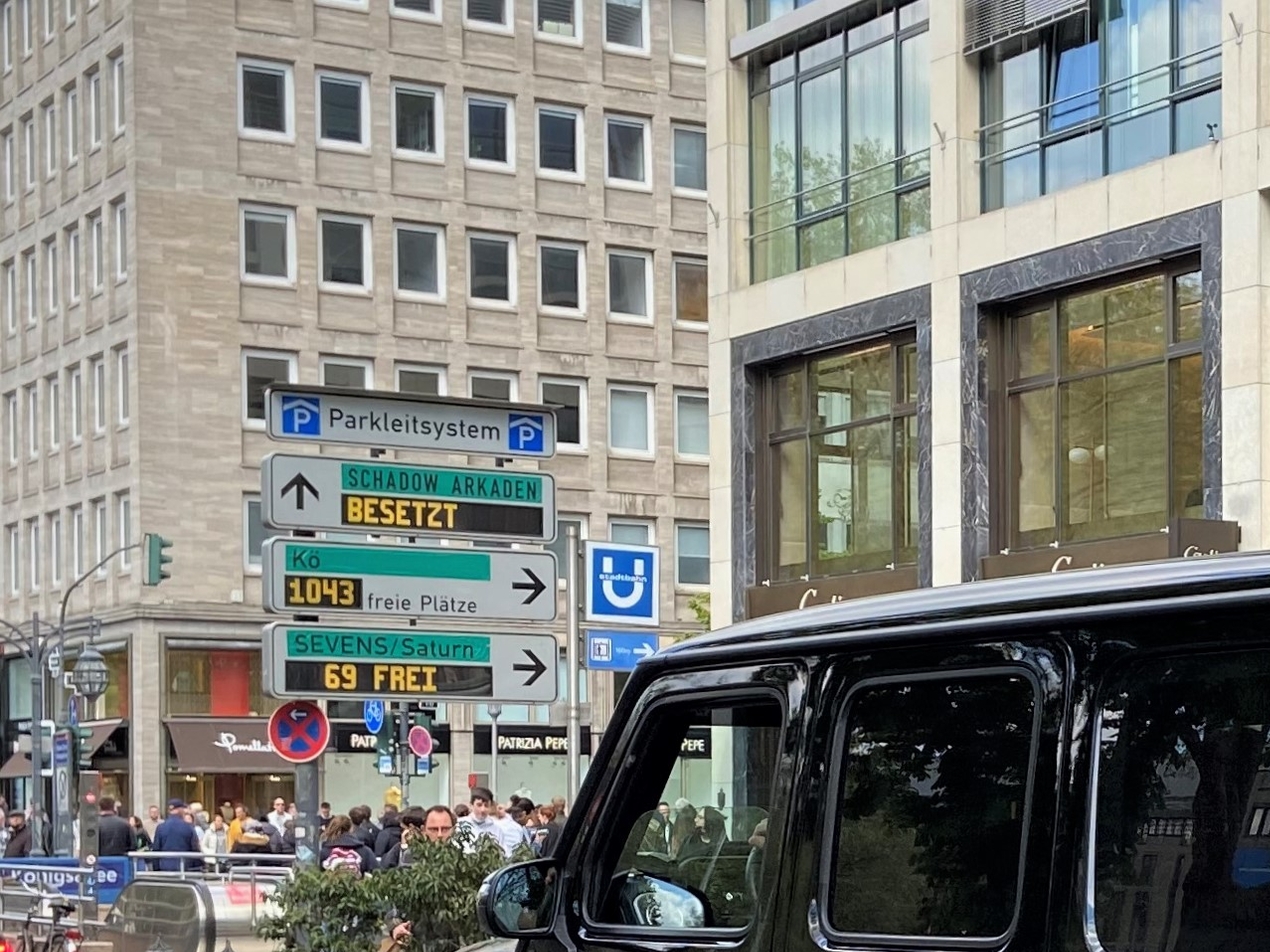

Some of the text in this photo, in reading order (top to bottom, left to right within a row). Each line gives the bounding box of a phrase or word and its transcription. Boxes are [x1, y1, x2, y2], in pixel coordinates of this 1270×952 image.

[329, 408, 501, 441] Parkleitsystem
[348, 467, 537, 500] SCHADOW ARKADEN
[347, 496, 458, 529] BESETZT
[292, 551, 321, 569] Kö
[289, 578, 478, 613] 1043 freie Plätze
[294, 634, 474, 659] SEVENS/Saturn
[324, 663, 438, 693] 69 FREI
[212, 731, 275, 754] Pomellat
[498, 736, 543, 750] PATRIZIA
